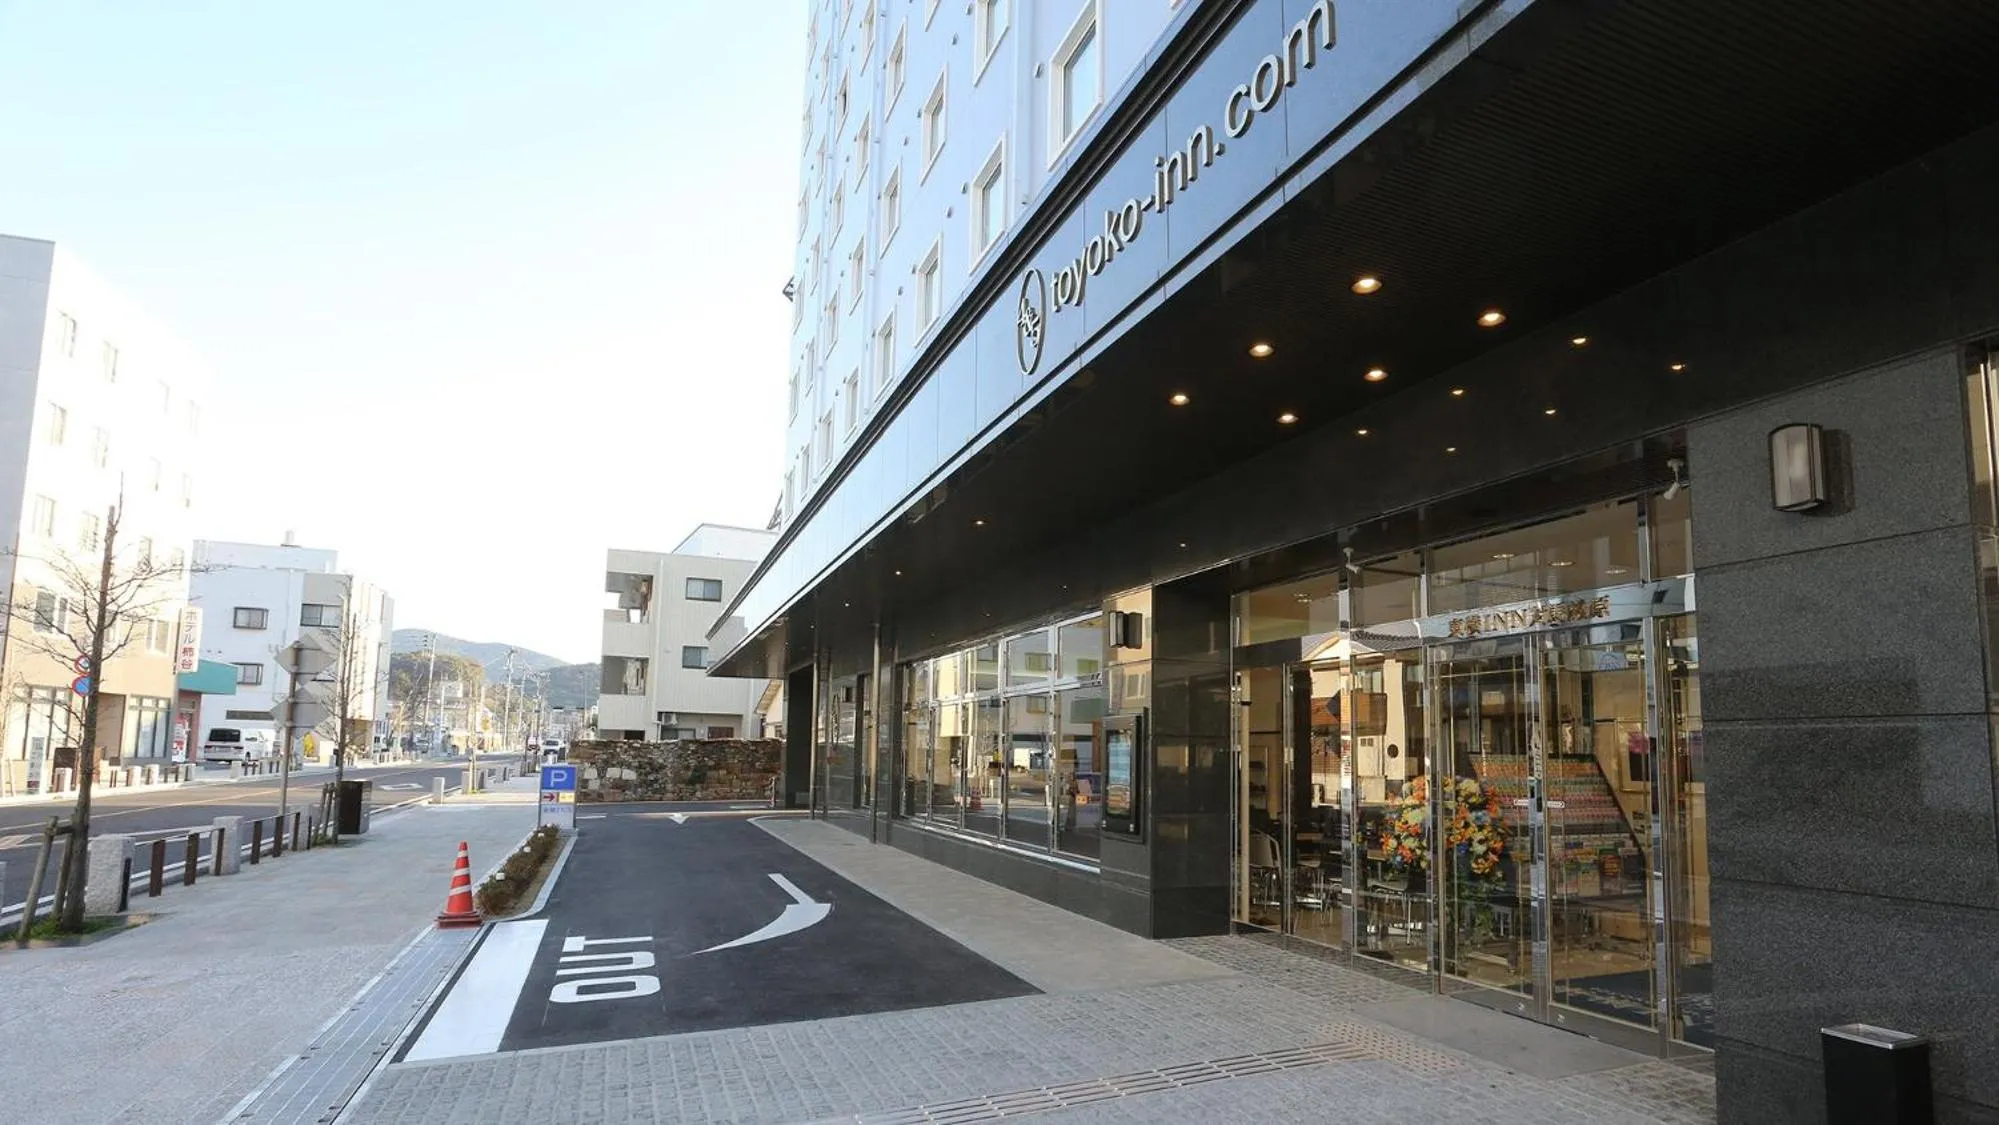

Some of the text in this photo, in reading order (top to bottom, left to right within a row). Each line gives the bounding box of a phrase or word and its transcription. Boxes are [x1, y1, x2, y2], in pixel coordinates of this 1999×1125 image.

[1049, 0, 1336, 313] toyoko-inn.com
[550, 769, 568, 788] P
[549, 936, 661, 1003] OUT
